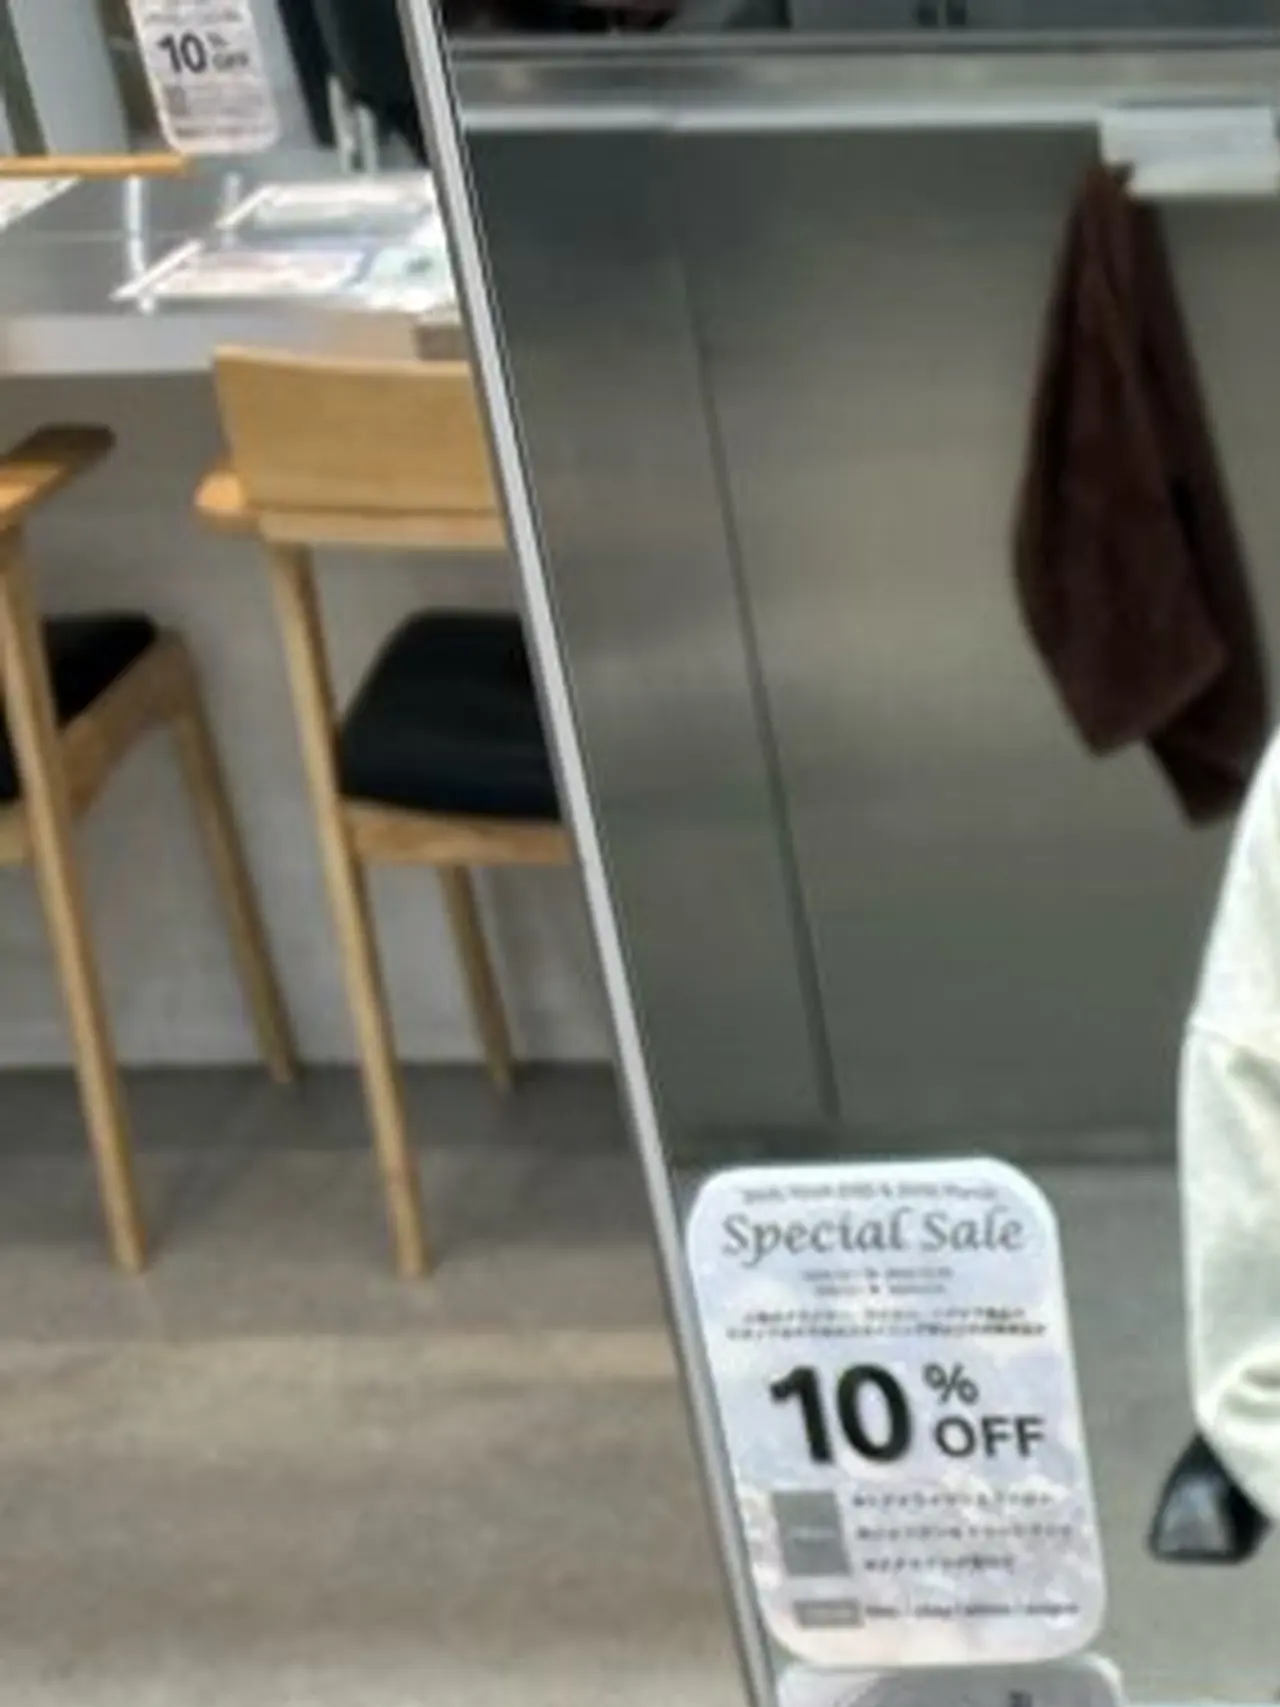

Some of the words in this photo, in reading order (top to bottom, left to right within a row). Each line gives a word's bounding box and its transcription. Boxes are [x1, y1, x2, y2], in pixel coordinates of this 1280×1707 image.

[157, 32, 208, 74] 10
[721, 1206, 913, 1269] Special
[919, 1204, 1025, 1254] Sale
[923, 1362, 980, 1406] %
[769, 1362, 912, 1467] 10
[935, 1414, 1046, 1459] OFF
